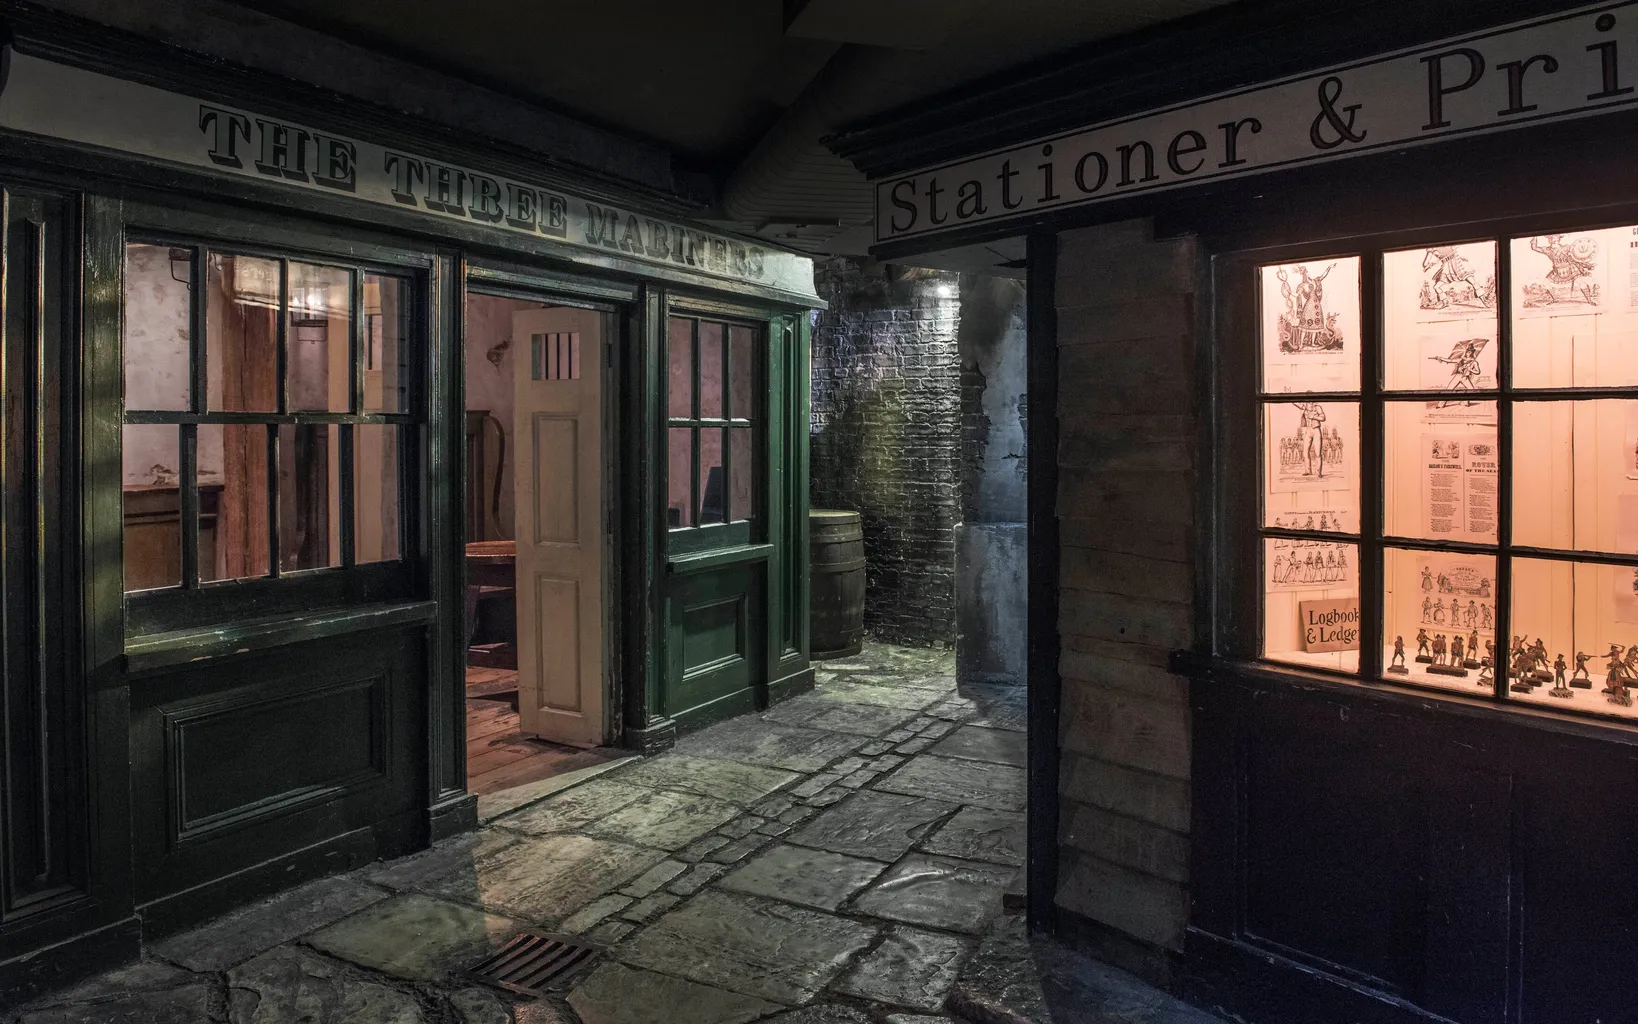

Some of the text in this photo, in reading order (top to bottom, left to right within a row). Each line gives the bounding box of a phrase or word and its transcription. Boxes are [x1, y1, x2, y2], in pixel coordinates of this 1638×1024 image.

[890, 13, 1635, 235] Stationer & Pri
[199, 104, 765, 280] THE THREE MARINERS
[1306, 626, 1359, 645] & Ledge
[1309, 607, 1359, 626] Logbook
